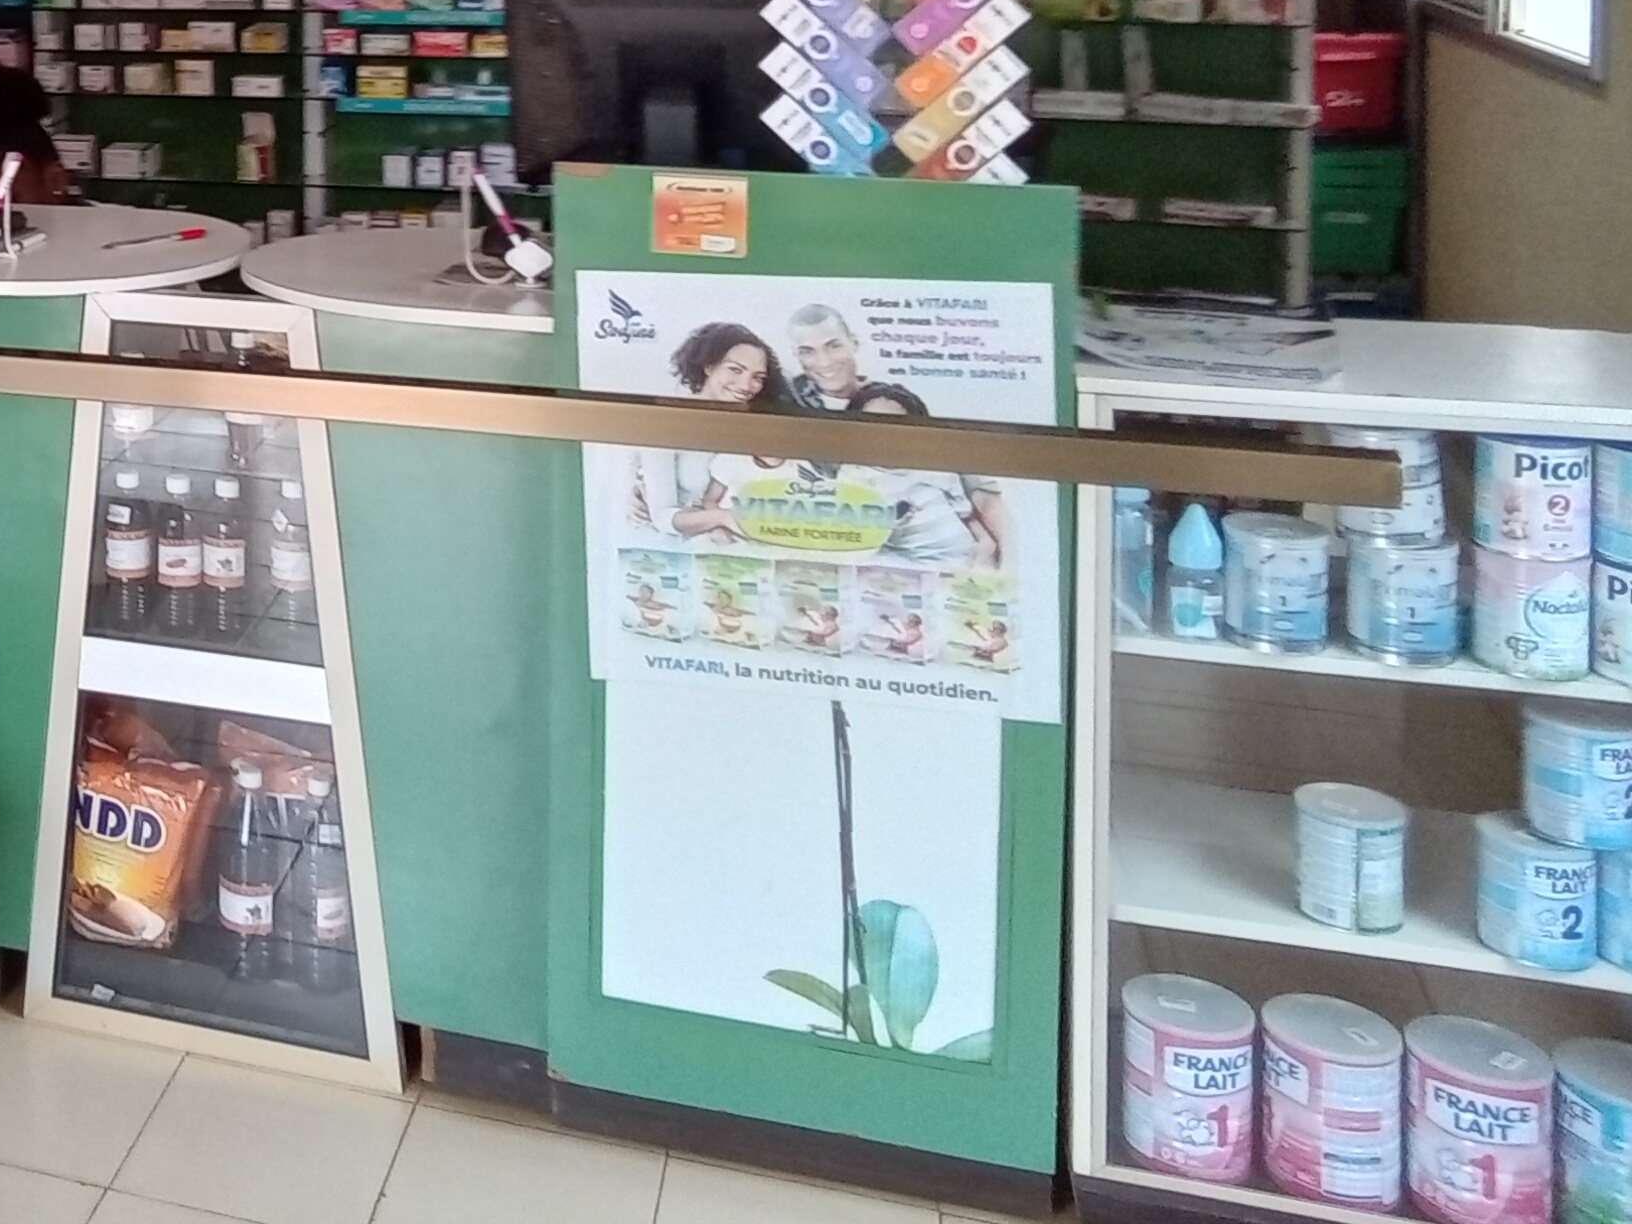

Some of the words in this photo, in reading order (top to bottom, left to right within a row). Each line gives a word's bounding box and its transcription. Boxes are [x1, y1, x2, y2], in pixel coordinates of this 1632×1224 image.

[867, 315, 894, 327] que
[898, 317, 932, 327] nous
[870, 331, 939, 346] chaque
[895, 348, 945, 361] famille
[947, 351, 971, 362] est
[973, 350, 1042, 365] toujours
[887, 366, 907, 376] en
[909, 364, 964, 378] bonne
[969, 366, 1018, 380] santé
[1550, 495, 1568, 516] 2
[759, 525, 801, 539] FARINE
[644, 652, 729, 678] VITAFARI,
[735, 661, 753, 678] la
[758, 663, 850, 689] nutrition
[855, 675, 882, 692] au
[887, 676, 999, 704] quotidien.
[1551, 880, 1586, 895] LAIT
[1561, 904, 1584, 941] 2
[1193, 1072, 1240, 1091] LAIT
[1432, 1084, 1531, 1123] FRANCE
[1206, 1103, 1230, 1148] 1
[1453, 1111, 1515, 1142] LAIT
[1469, 1153, 1497, 1201] 1
